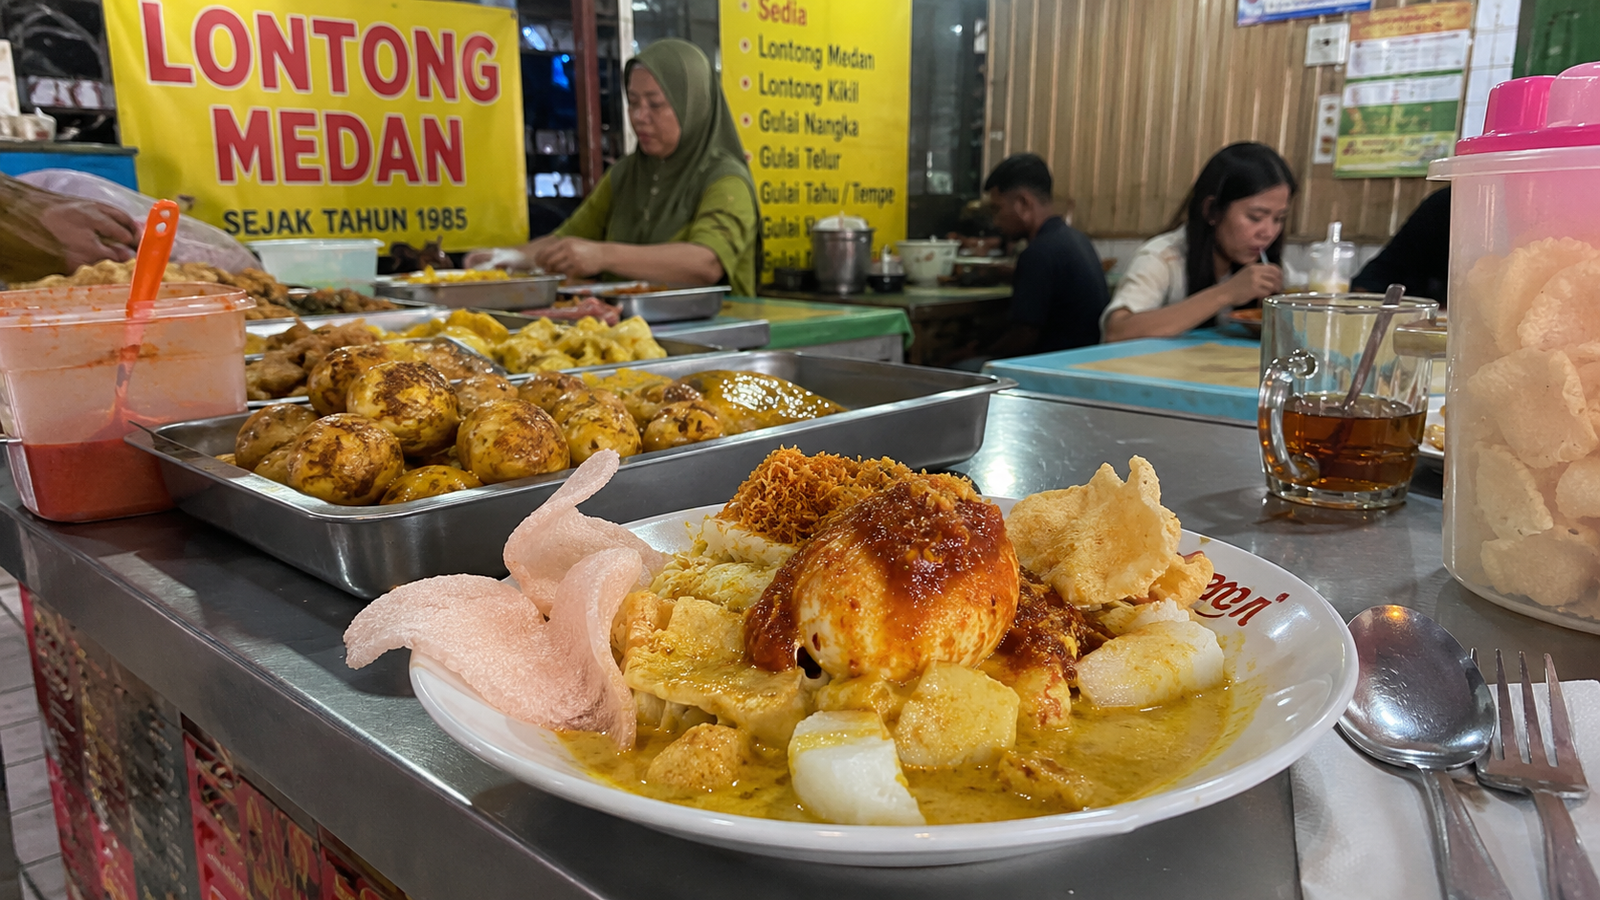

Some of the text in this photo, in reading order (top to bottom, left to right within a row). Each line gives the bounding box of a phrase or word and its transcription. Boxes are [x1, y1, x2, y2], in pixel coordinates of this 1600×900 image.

[758, 0, 807, 26] Sedia
[139, 1, 500, 103] LONTONG
[758, 34, 875, 70] Lontong Medan
[759, 72, 859, 106] Lontong Kikil
[759, 109, 860, 142] Gulai Nangka
[211, 107, 466, 185] MEDAN
[759, 145, 841, 170] Gulai Telur
[760, 181, 800, 205] Gulai
[804, 181, 839, 205] Tahu
[852, 182, 896, 208] Tempe
[223, 207, 468, 236] SEJAK TAHUN 1985
[761, 215, 800, 239] Gulai
